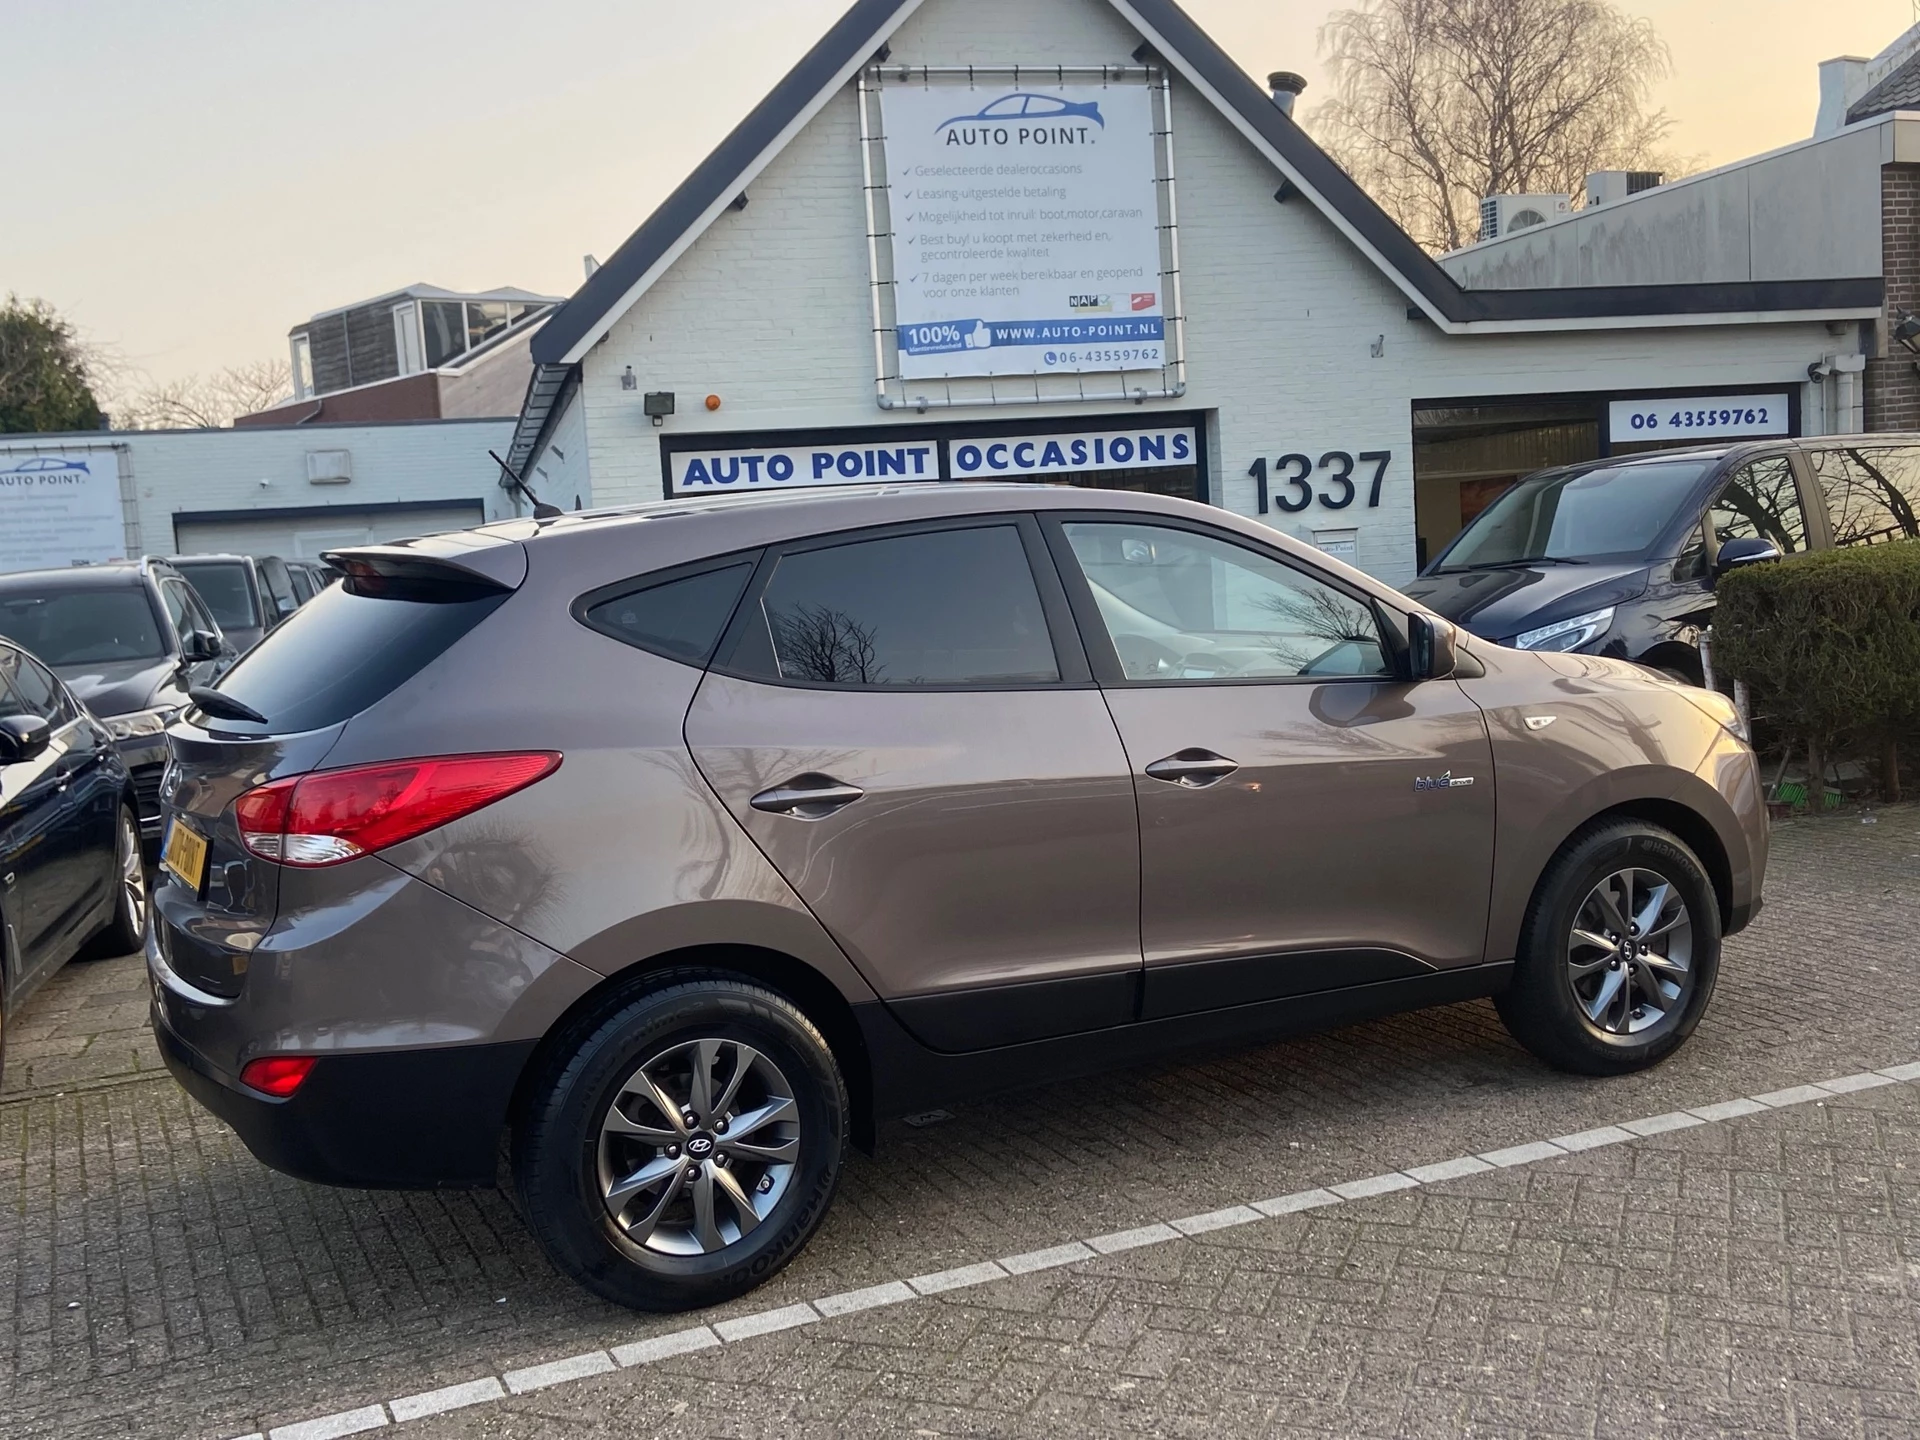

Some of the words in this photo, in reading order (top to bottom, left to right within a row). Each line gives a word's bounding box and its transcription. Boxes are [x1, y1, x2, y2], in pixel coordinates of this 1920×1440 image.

[946, 128, 1009, 146] AUTO
[1019, 127, 1096, 145] POINT.
[915, 164, 994, 177] Geselecteerde
[996, 162, 1083, 175] dealeroccasions
[916, 186, 1021, 201] Leasing-uitgestelde
[1023, 185, 1067, 200] betaling
[918, 208, 987, 224] Mogelijkheid
[989, 211, 1004, 221] tot
[1039, 208, 1143, 220] boot,motor,caravan
[920, 234, 944, 245] Best
[946, 233, 970, 247] buy!
[972, 236, 980, 244] u
[982, 232, 1013, 246] koopt
[1016, 233, 1038, 243] met
[1040, 230, 1092, 242] zekerheid
[920, 247, 1004, 263] gecontroleerde
[1006, 246, 1050, 258] kwaliteit
[922, 272, 930, 283] 7
[932, 272, 967, 286] dagen
[969, 273, 988, 284] per
[989, 269, 1019, 281] week
[1020, 268, 1078, 281] bereikbaar
[1080, 269, 1094, 279] en
[1096, 266, 1144, 281] geopend
[923, 288, 948, 298] voor
[950, 287, 978, 297] onze
[980, 285, 1020, 297] klanten
[1069, 294, 1099, 307] NAP
[908, 324, 961, 345] 100%
[996, 323, 1158, 340] WWW.AUTO-POINT.NL
[1059, 348, 1159, 364] 06-43559762
[1630, 413, 1658, 430] 06
[1668, 408, 1769, 429] 43559762
[956, 433, 1190, 472] OCCASIONS
[682, 453, 795, 486] AUTO
[812, 446, 931, 479] POINT
[1248, 450, 1392, 515] 1337
[1414, 776, 1450, 792] blue
